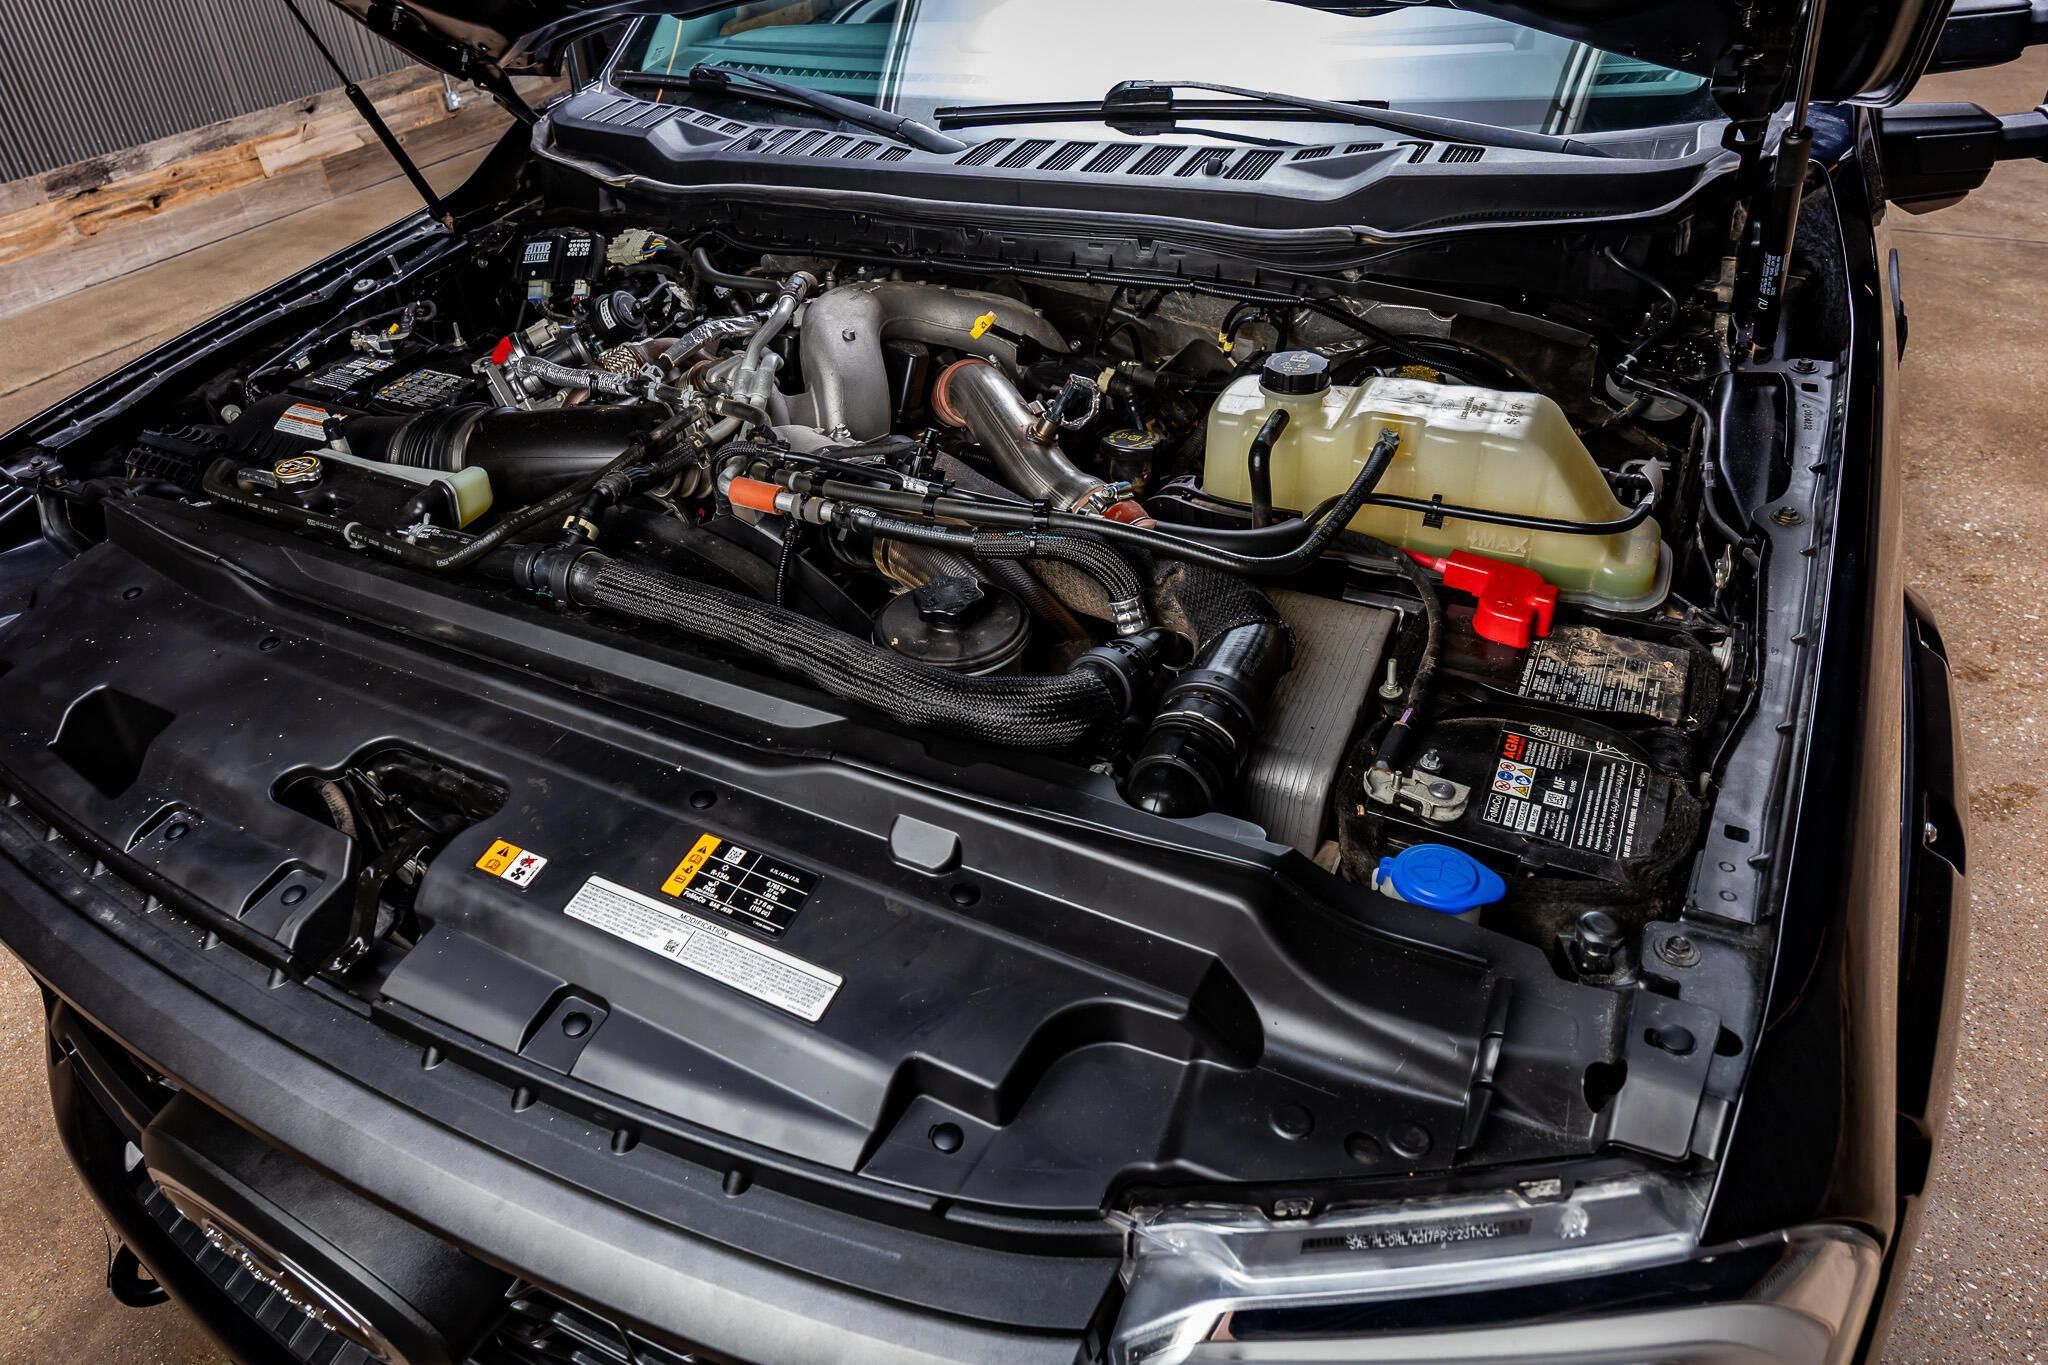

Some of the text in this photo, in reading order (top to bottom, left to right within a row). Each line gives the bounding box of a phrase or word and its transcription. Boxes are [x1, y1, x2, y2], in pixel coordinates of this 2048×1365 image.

[1503, 734, 1520, 759] AGM
[1553, 776, 1566, 790] MF
[1487, 794, 1503, 822] FoMoCo
[710, 869, 730, 881] R-134a
[702, 884, 716, 894] PAG
[683, 890, 707, 904] FoMoCo
[679, 912, 729, 938] MODIFICATION
